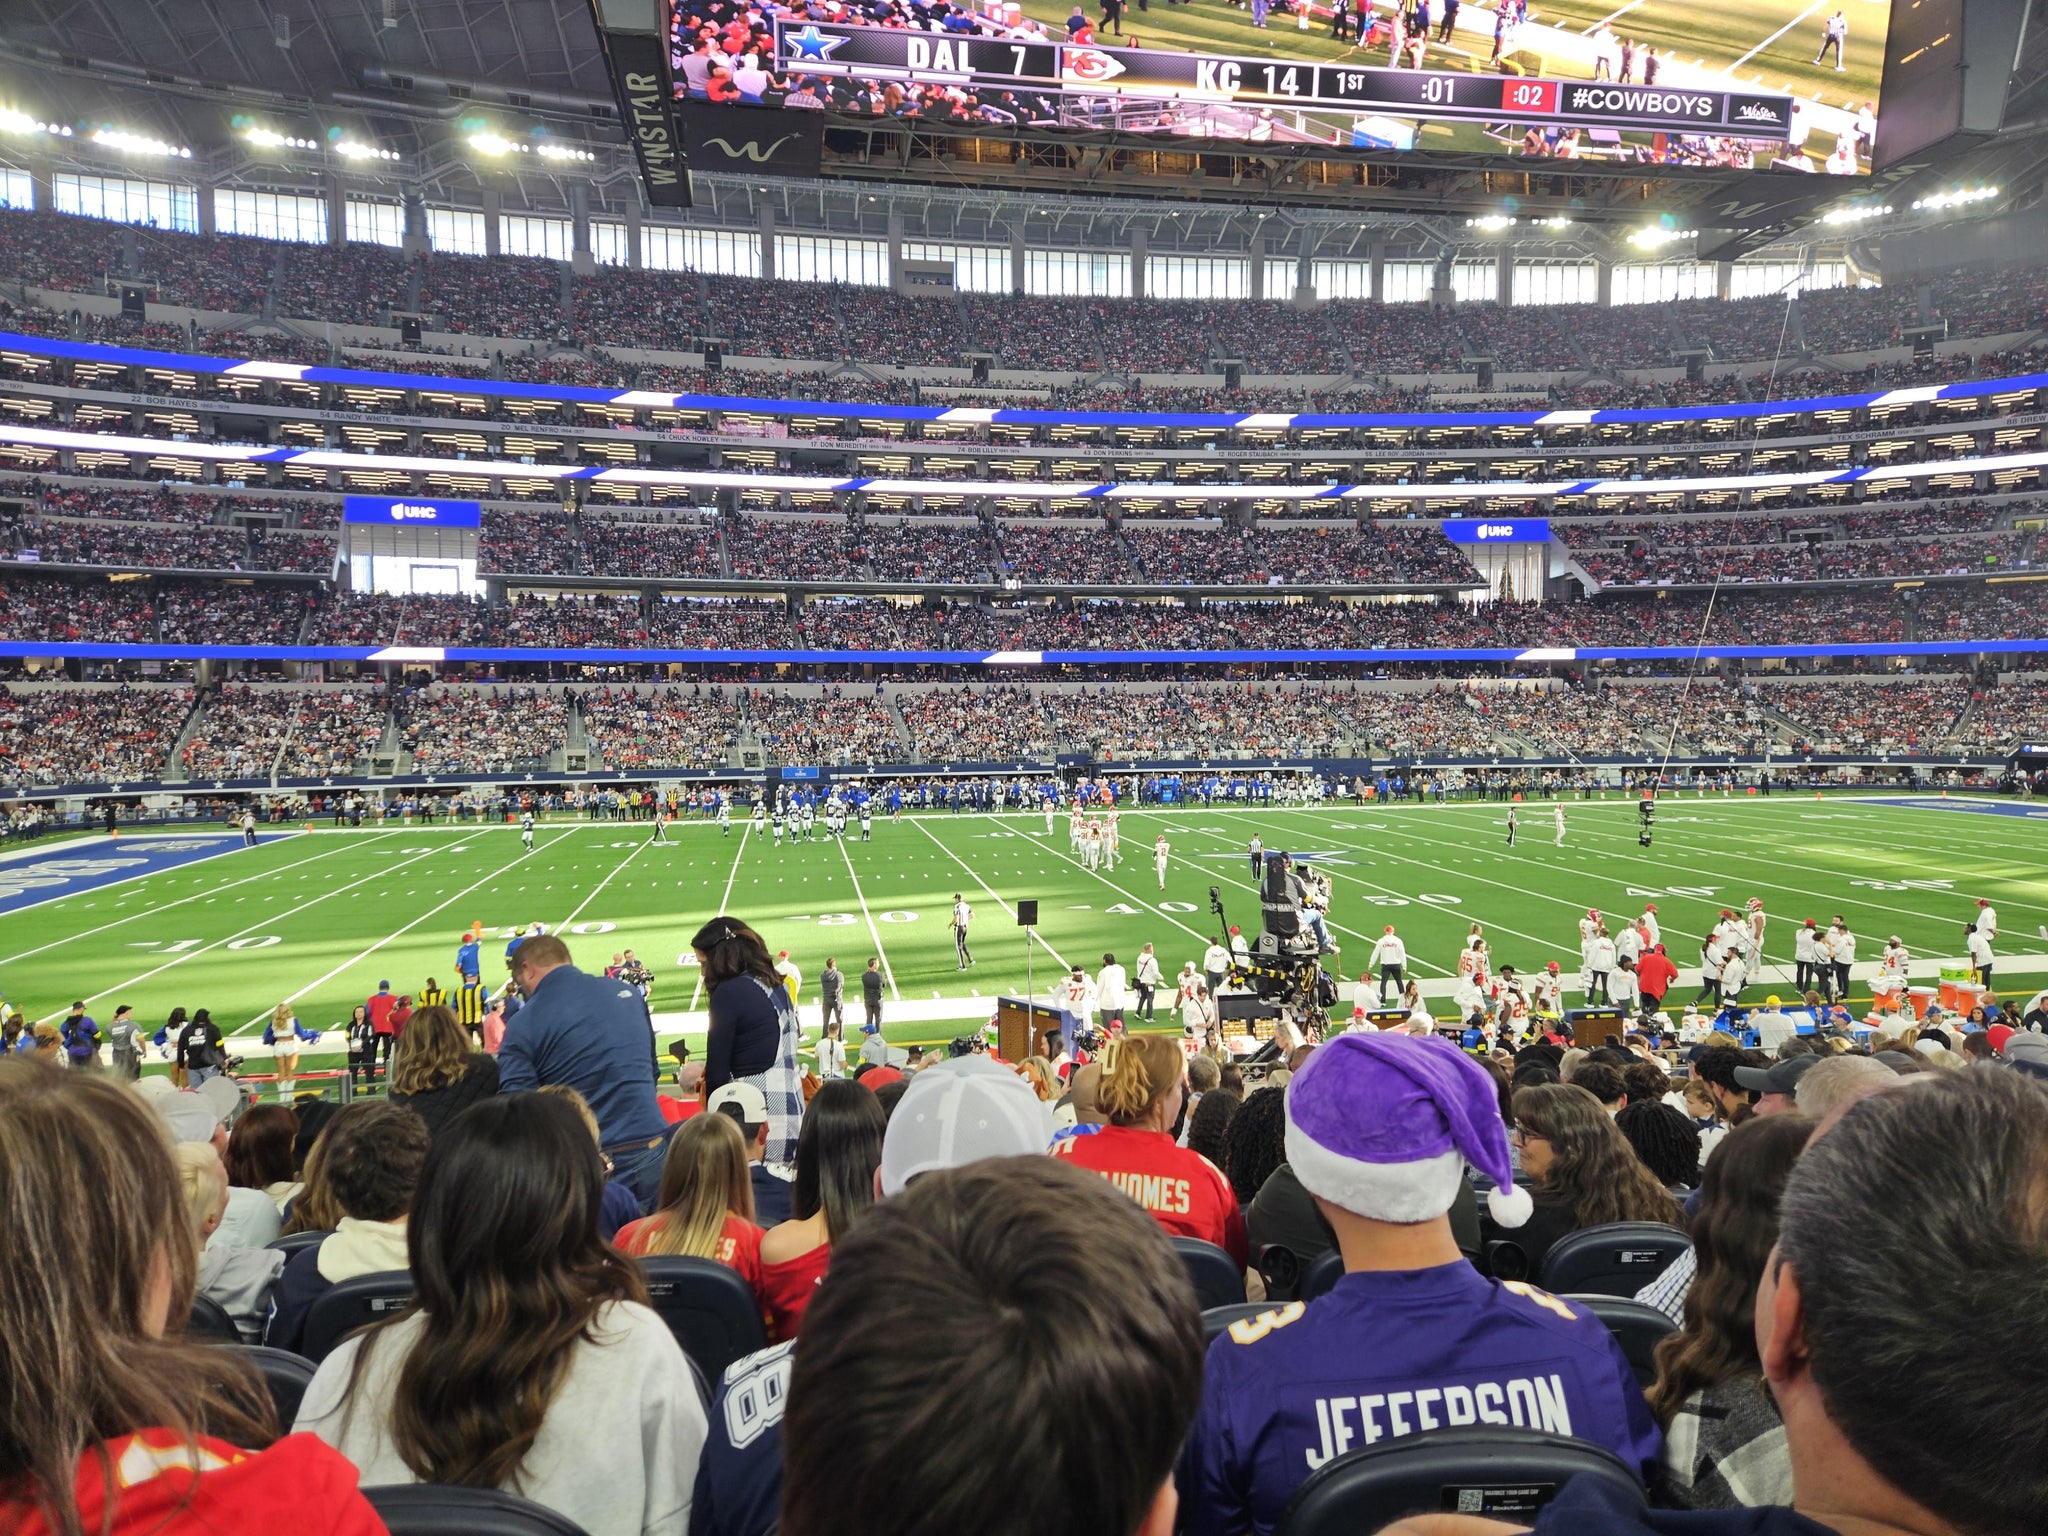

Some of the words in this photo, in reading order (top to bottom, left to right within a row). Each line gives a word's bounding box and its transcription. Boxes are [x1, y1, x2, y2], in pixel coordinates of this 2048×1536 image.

[907, 36, 976, 73] DAL
[1010, 45, 1026, 76] 7
[1196, 60, 1242, 94] KC
[1262, 66, 1300, 96] 14
[1336, 72, 1365, 94] 1ST
[1421, 77, 1455, 103] :01
[1512, 84, 1542, 106] :02
[1572, 88, 1713, 116] #COWBOYS
[626, 73, 677, 185] WINSTAR
[131, 395, 142, 403] 22
[146, 397, 166, 406] BOB
[168, 398, 198, 409] HAYES
[320, 411, 330, 419] 54
[334, 412, 362, 421] RANDY
[365, 414, 392, 423] WHITE
[2020, 415, 2047, 424] DREW
[501, 423, 511, 431] 20
[530, 425, 559, 434] RENFRO
[1837, 433, 1852, 441] TEX
[1854, 430, 1896, 440] SCHRAMM
[691, 435, 719, 443] HOWLEY
[835, 442, 868, 450] MEREDITH
[405, 505, 437, 519] UHC
[1488, 525, 1514, 537] UHC
[1361, 893, 1463, 906] 50
[1104, 901, 1200, 914] 40
[816, 910, 920, 926] 30
[149, 935, 283, 952] 10
[1069, 987, 1086, 1002] 77
[1305, 1374, 1573, 1471] JEFFERSON
